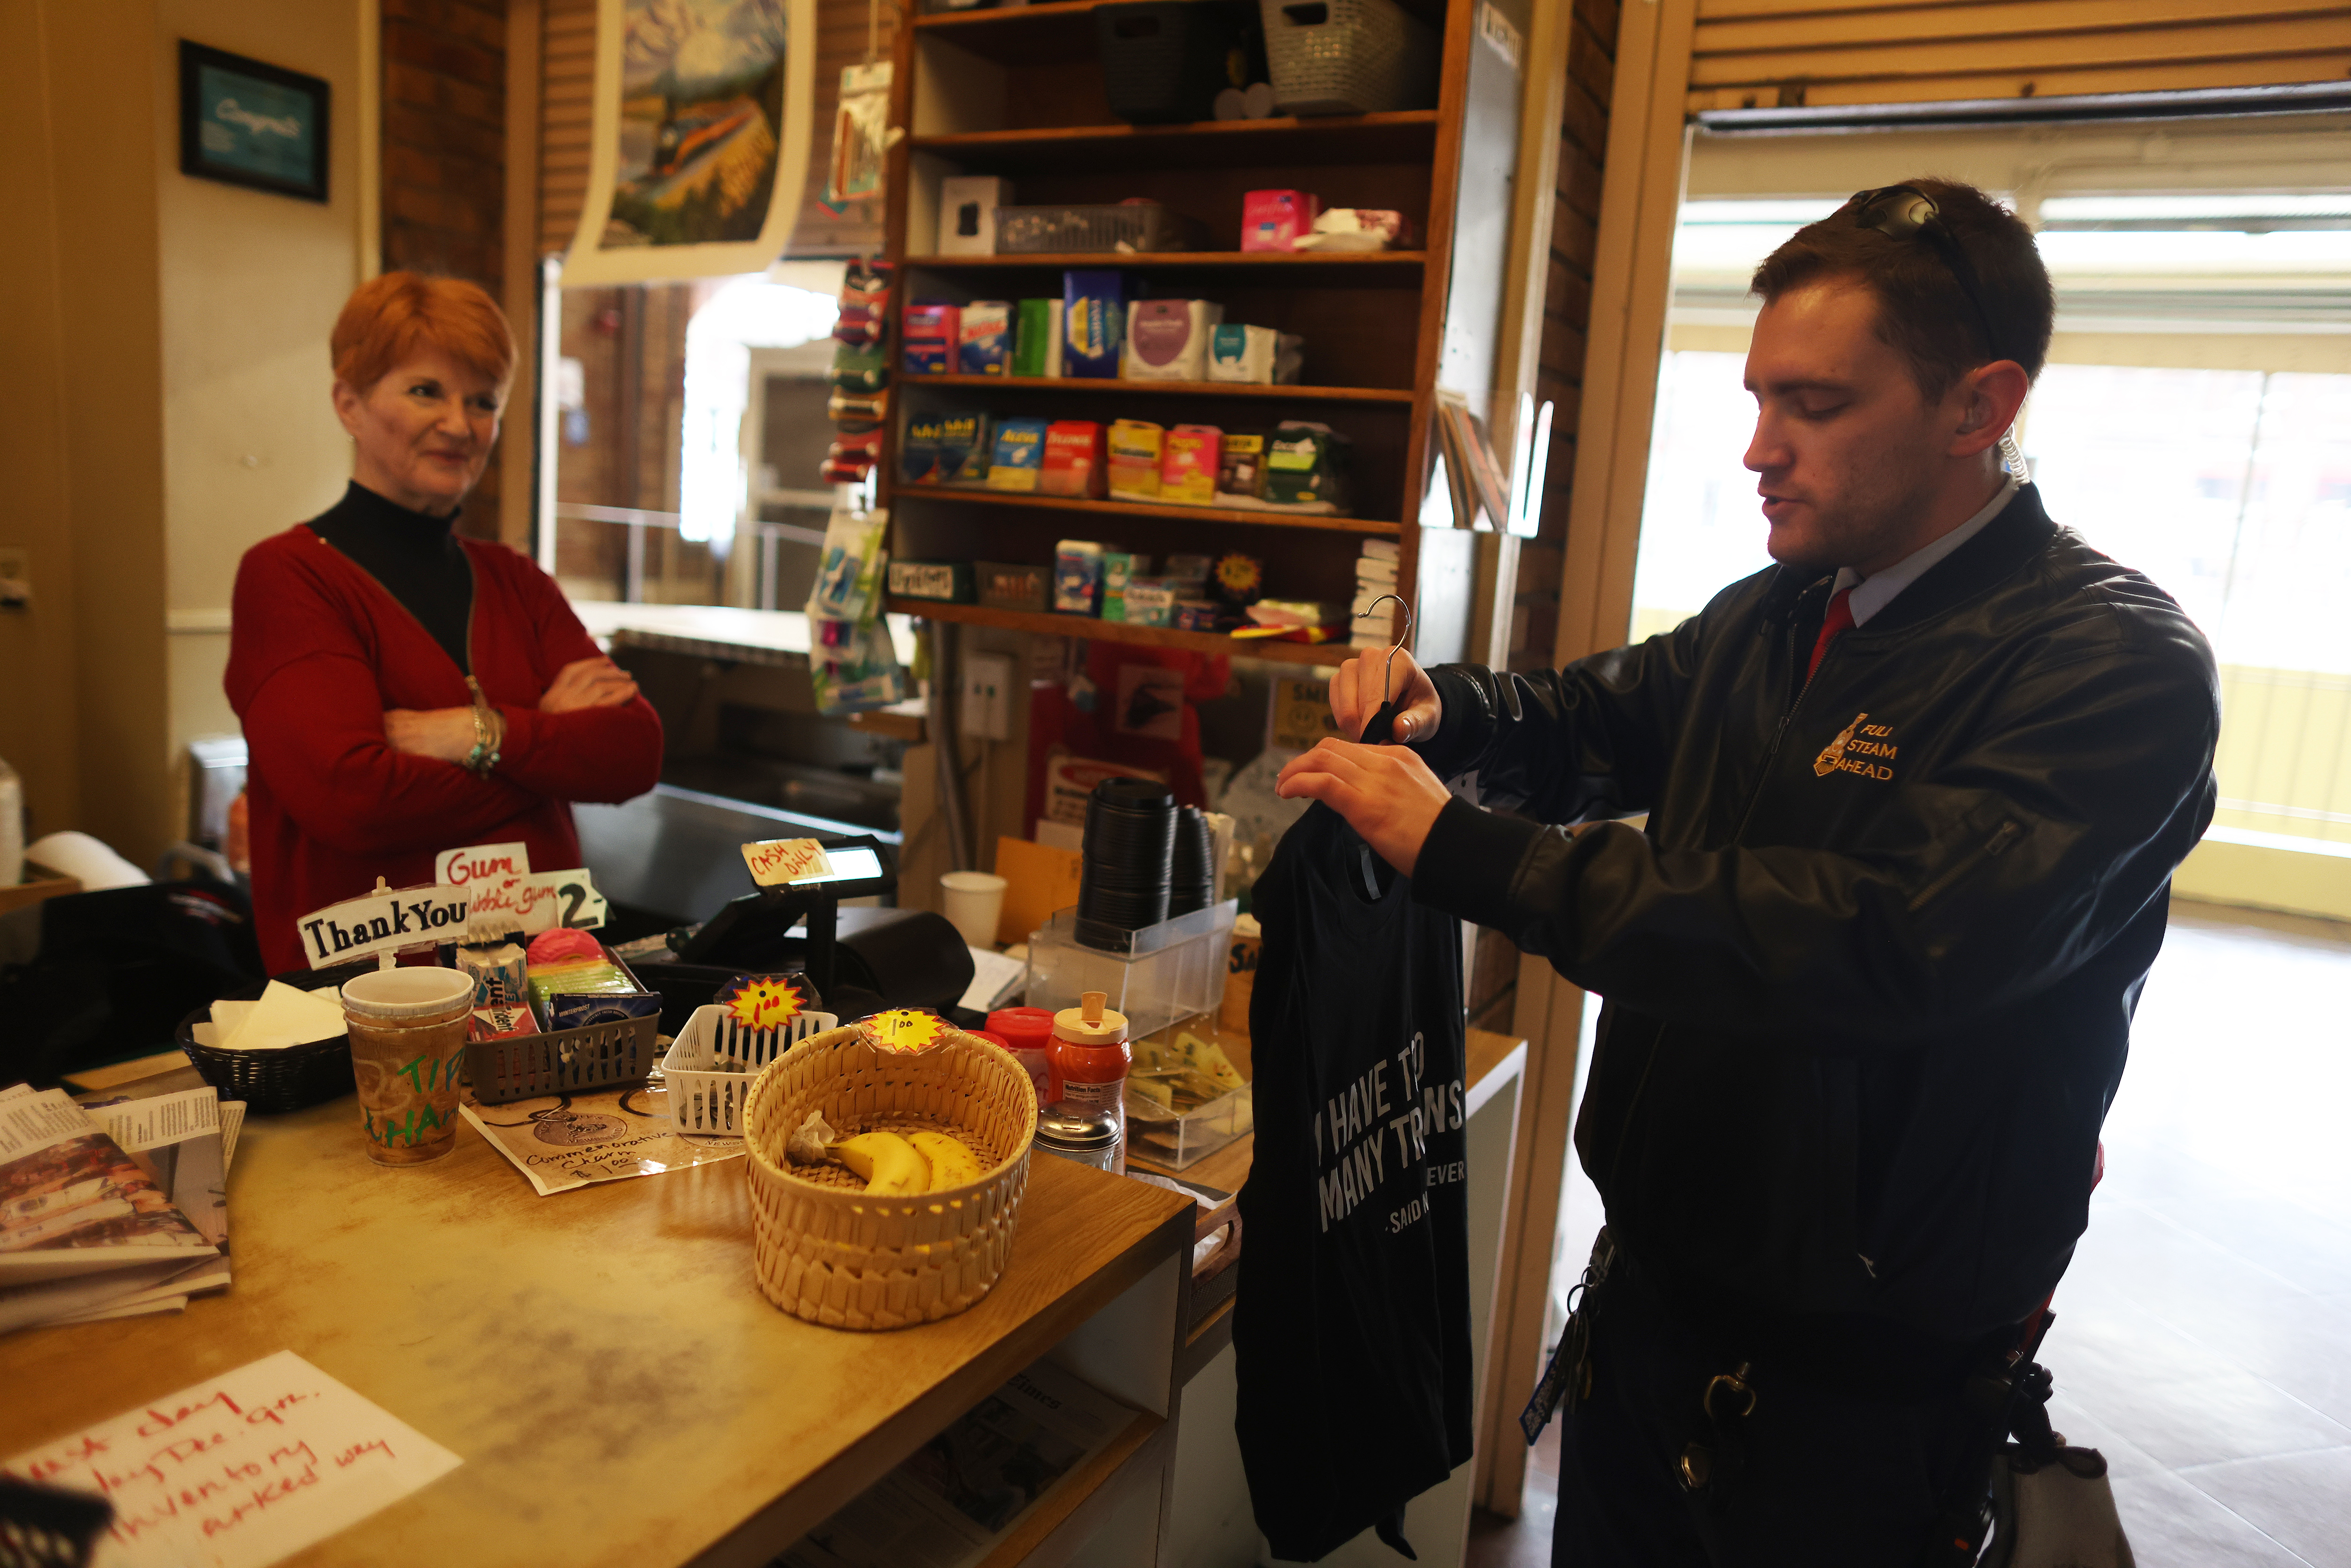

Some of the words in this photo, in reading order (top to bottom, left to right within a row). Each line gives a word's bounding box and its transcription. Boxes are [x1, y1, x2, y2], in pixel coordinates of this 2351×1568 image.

[1860, 724, 1893, 737] FULL
[1847, 739, 1898, 760] STEAM
[1835, 757, 1894, 781] AHEAD
[448, 851, 521, 885] Gum
[751, 844, 789, 875] CASH
[515, 885, 556, 914] gum
[558, 1003, 591, 1017] WINTERFROST
[1065, 1084, 1087, 1093] Nutrition
[1328, 1059, 1390, 1155] HAVE
[526, 1132, 675, 1166] Commemorative
[561, 1151, 636, 1169] Charm
[1318, 1127, 1384, 1233] MANY
[1389, 1199, 1422, 1233] SAID
[1427, 1160, 1465, 1187] EVER
[137, 1391, 243, 1438] day
[334, 1439, 397, 1469] way
